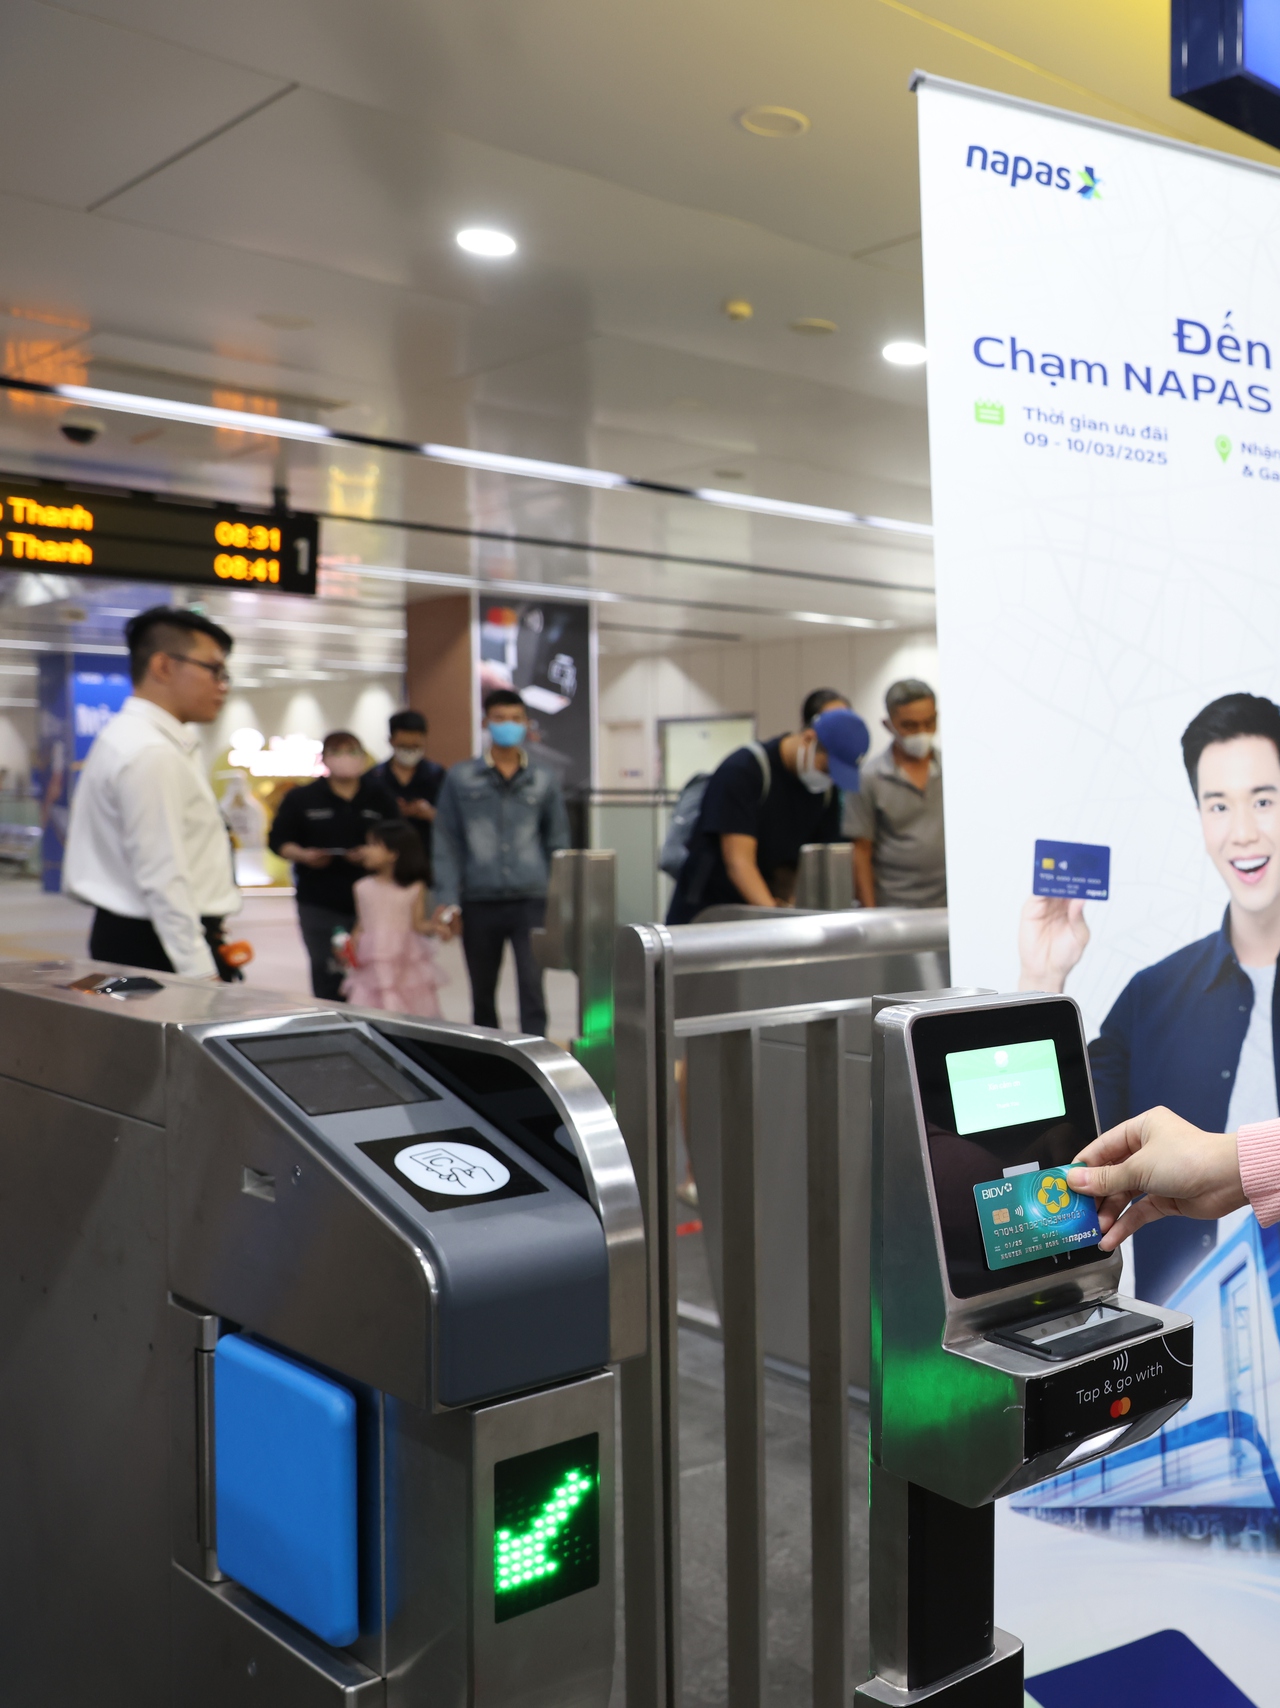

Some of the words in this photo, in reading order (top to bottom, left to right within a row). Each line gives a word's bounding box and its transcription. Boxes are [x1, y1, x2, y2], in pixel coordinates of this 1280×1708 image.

[966, 145, 1071, 190] napas
[1172, 311, 1271, 371] Đến
[973, 336, 1108, 387] Chạm
[1124, 361, 1273, 414] NAPAS
[1022, 406, 1065, 426] Thời
[1070, 414, 1109, 433] gian
[1114, 423, 1136, 438] ưu
[1140, 426, 1169, 442] đãi
[1024, 431, 1049, 447] 09
[1067, 437, 1168, 465] 10/03/2025
[1242, 465, 1254, 478] &
[1259, 467, 1280, 482] Ga
[7, 496, 94, 532] Thanh
[214, 520, 282, 552] 08:31
[6, 531, 93, 565] Thanh
[213, 553, 281, 584] 08:41
[981, 1185, 1004, 1200] BIDV
[1068, 1231, 1092, 1243] napas
[1076, 1388, 1100, 1404] Tap
[1103, 1380, 1112, 1394] &
[1116, 1376, 1132, 1392] go
[1135, 1362, 1163, 1382] with
